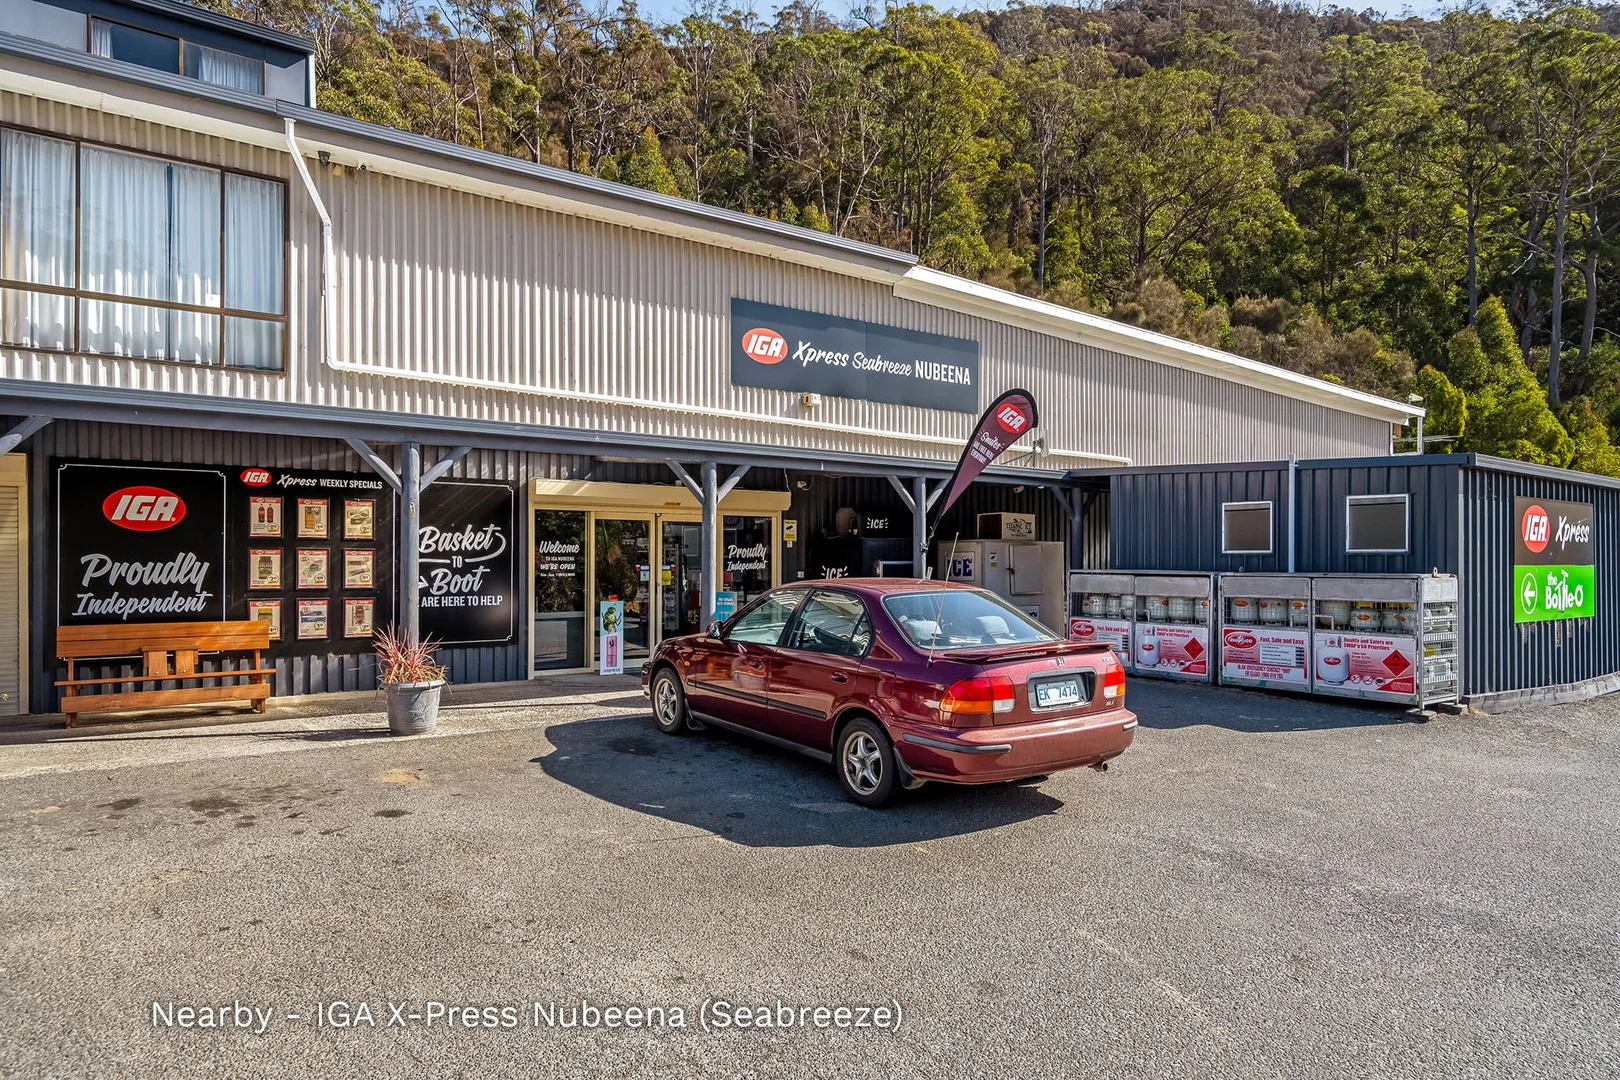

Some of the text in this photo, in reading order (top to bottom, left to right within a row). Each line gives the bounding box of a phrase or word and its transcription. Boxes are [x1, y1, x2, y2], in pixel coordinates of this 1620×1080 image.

[746, 334, 784, 357] IGA
[792, 340, 971, 386] Xpress Seabreeze NUBEENA
[998, 406, 1025, 430] IGA
[244, 472, 268, 483] IGA
[276, 474, 382, 490] Xpress WEEKLY SPECIALS
[111, 494, 179, 522] IGA
[870, 519, 884, 529] ICE
[1525, 515, 1548, 542] IGA
[418, 524, 502, 554] Basket
[1555, 516, 1590, 551] Xpress
[539, 540, 580, 554] Welcome
[728, 543, 767, 560] Proudly
[452, 556, 462, 568] TO
[726, 560, 768, 573] Independent
[947, 558, 972, 578] ICE
[80, 551, 210, 593] Proudly
[430, 565, 490, 595] Boot
[826, 568, 843, 579] ICE
[1547, 572, 1558, 585] the
[72, 590, 213, 620] Independent
[421, 596, 440, 608] ARE
[442, 596, 465, 606] HERE
[467, 596, 479, 606] TO
[481, 595, 503, 606] HELP
[1039, 686, 1077, 700] EK 7474
